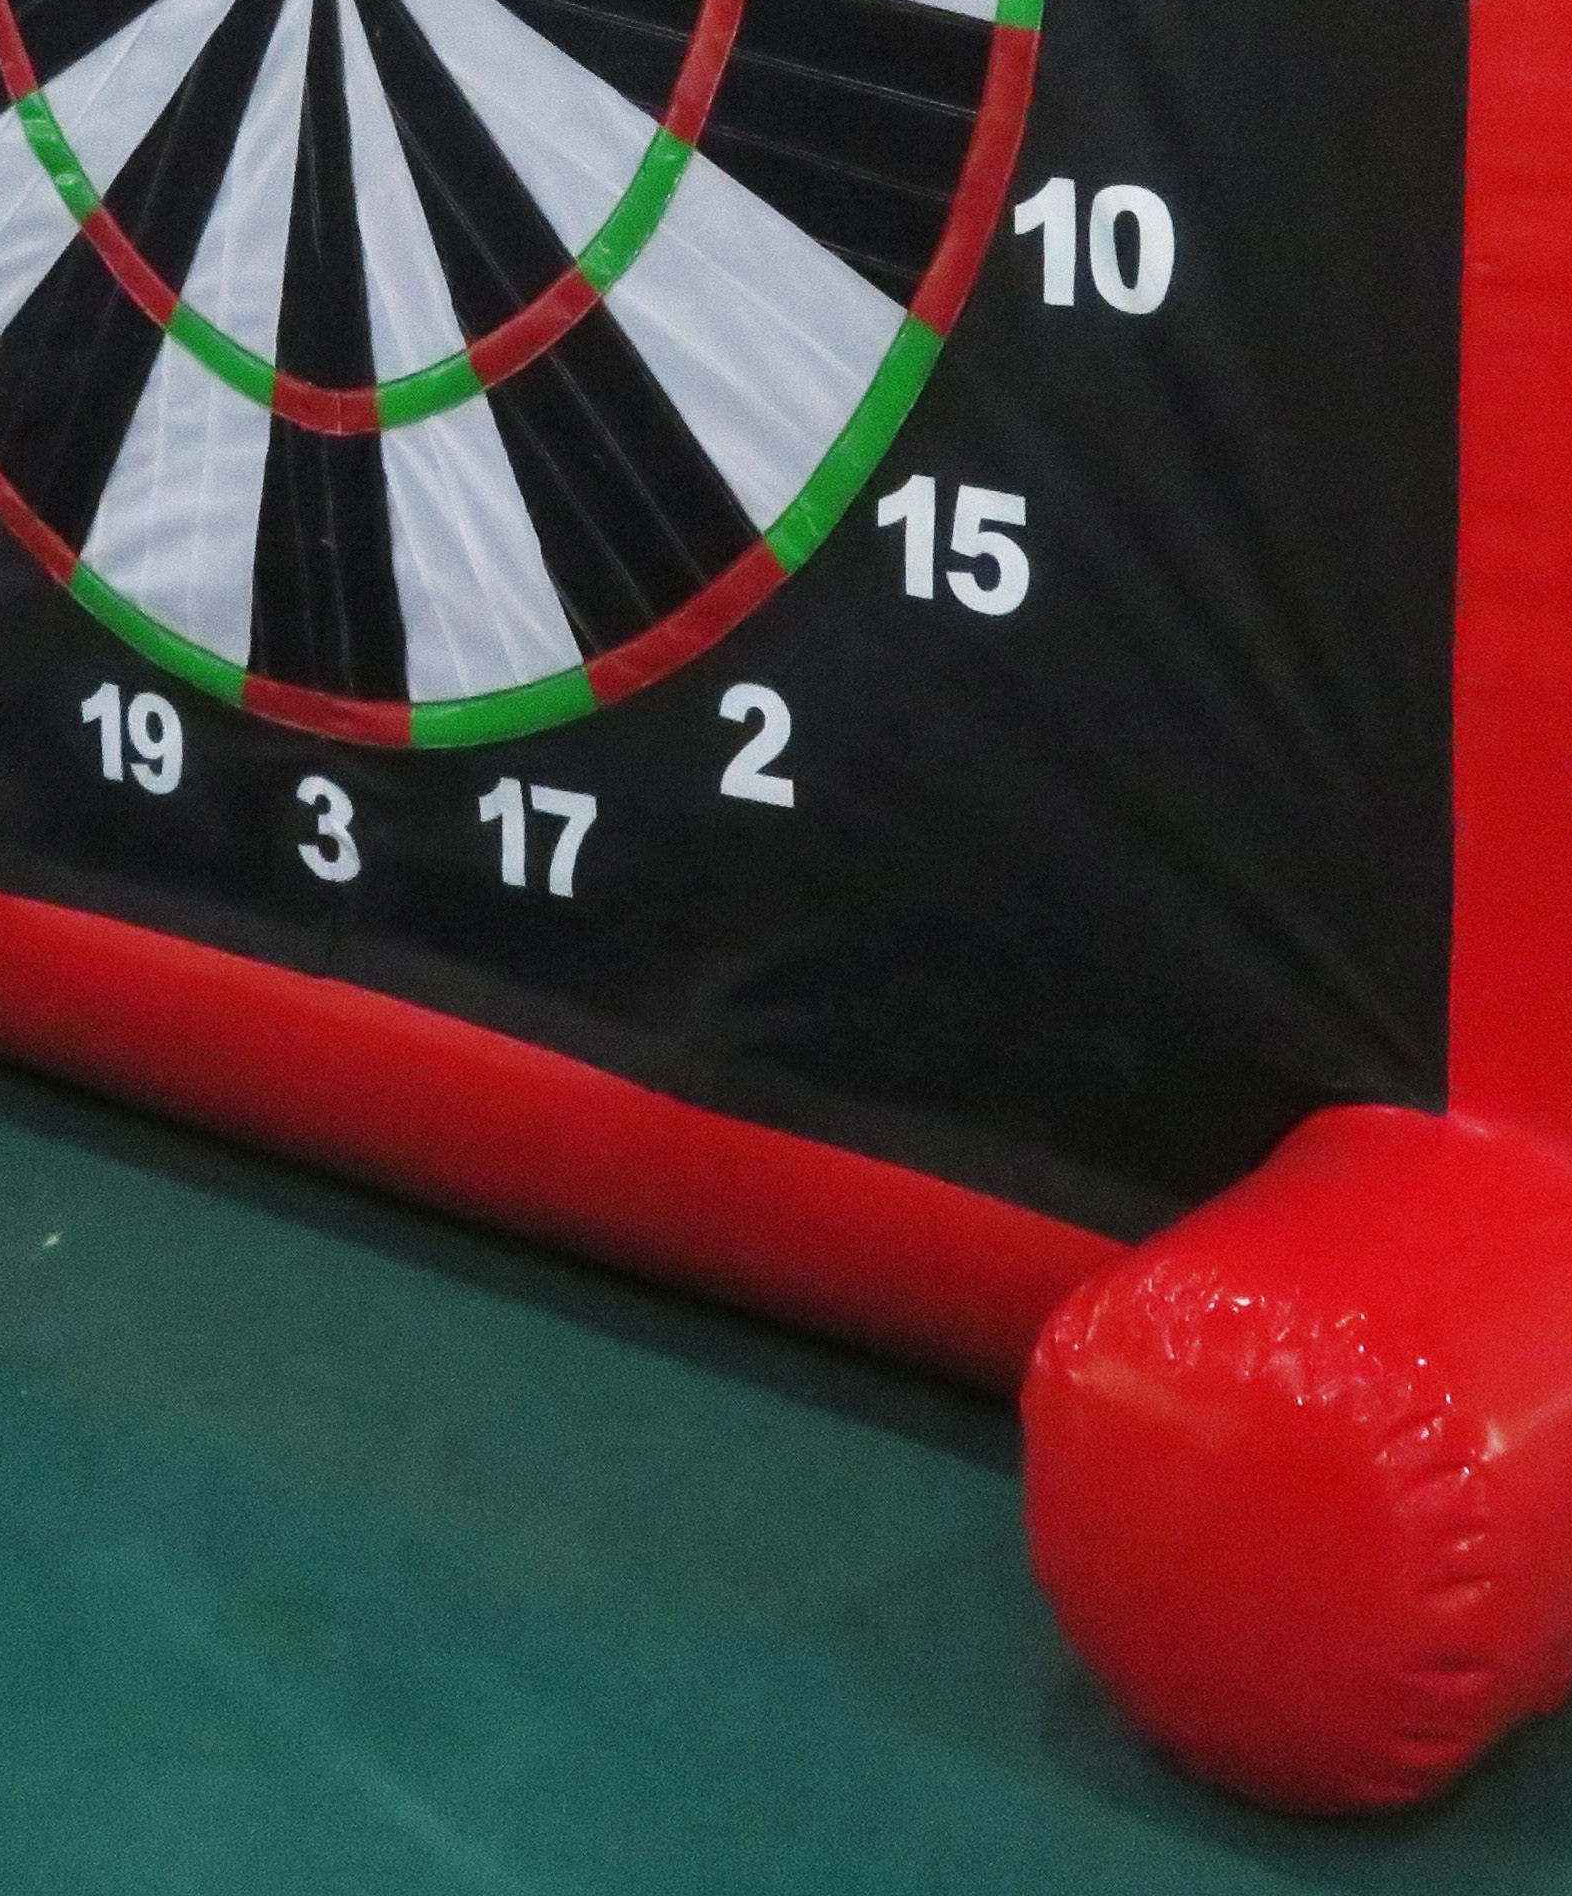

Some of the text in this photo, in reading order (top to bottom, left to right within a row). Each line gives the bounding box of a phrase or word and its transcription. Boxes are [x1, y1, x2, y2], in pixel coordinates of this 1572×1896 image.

[1015, 178, 1174, 314] 10
[878, 475, 1029, 615] 15
[82, 683, 183, 793] 19
[720, 683, 793, 807] 2
[298, 776, 360, 882] 3
[479, 778, 596, 897] 17
